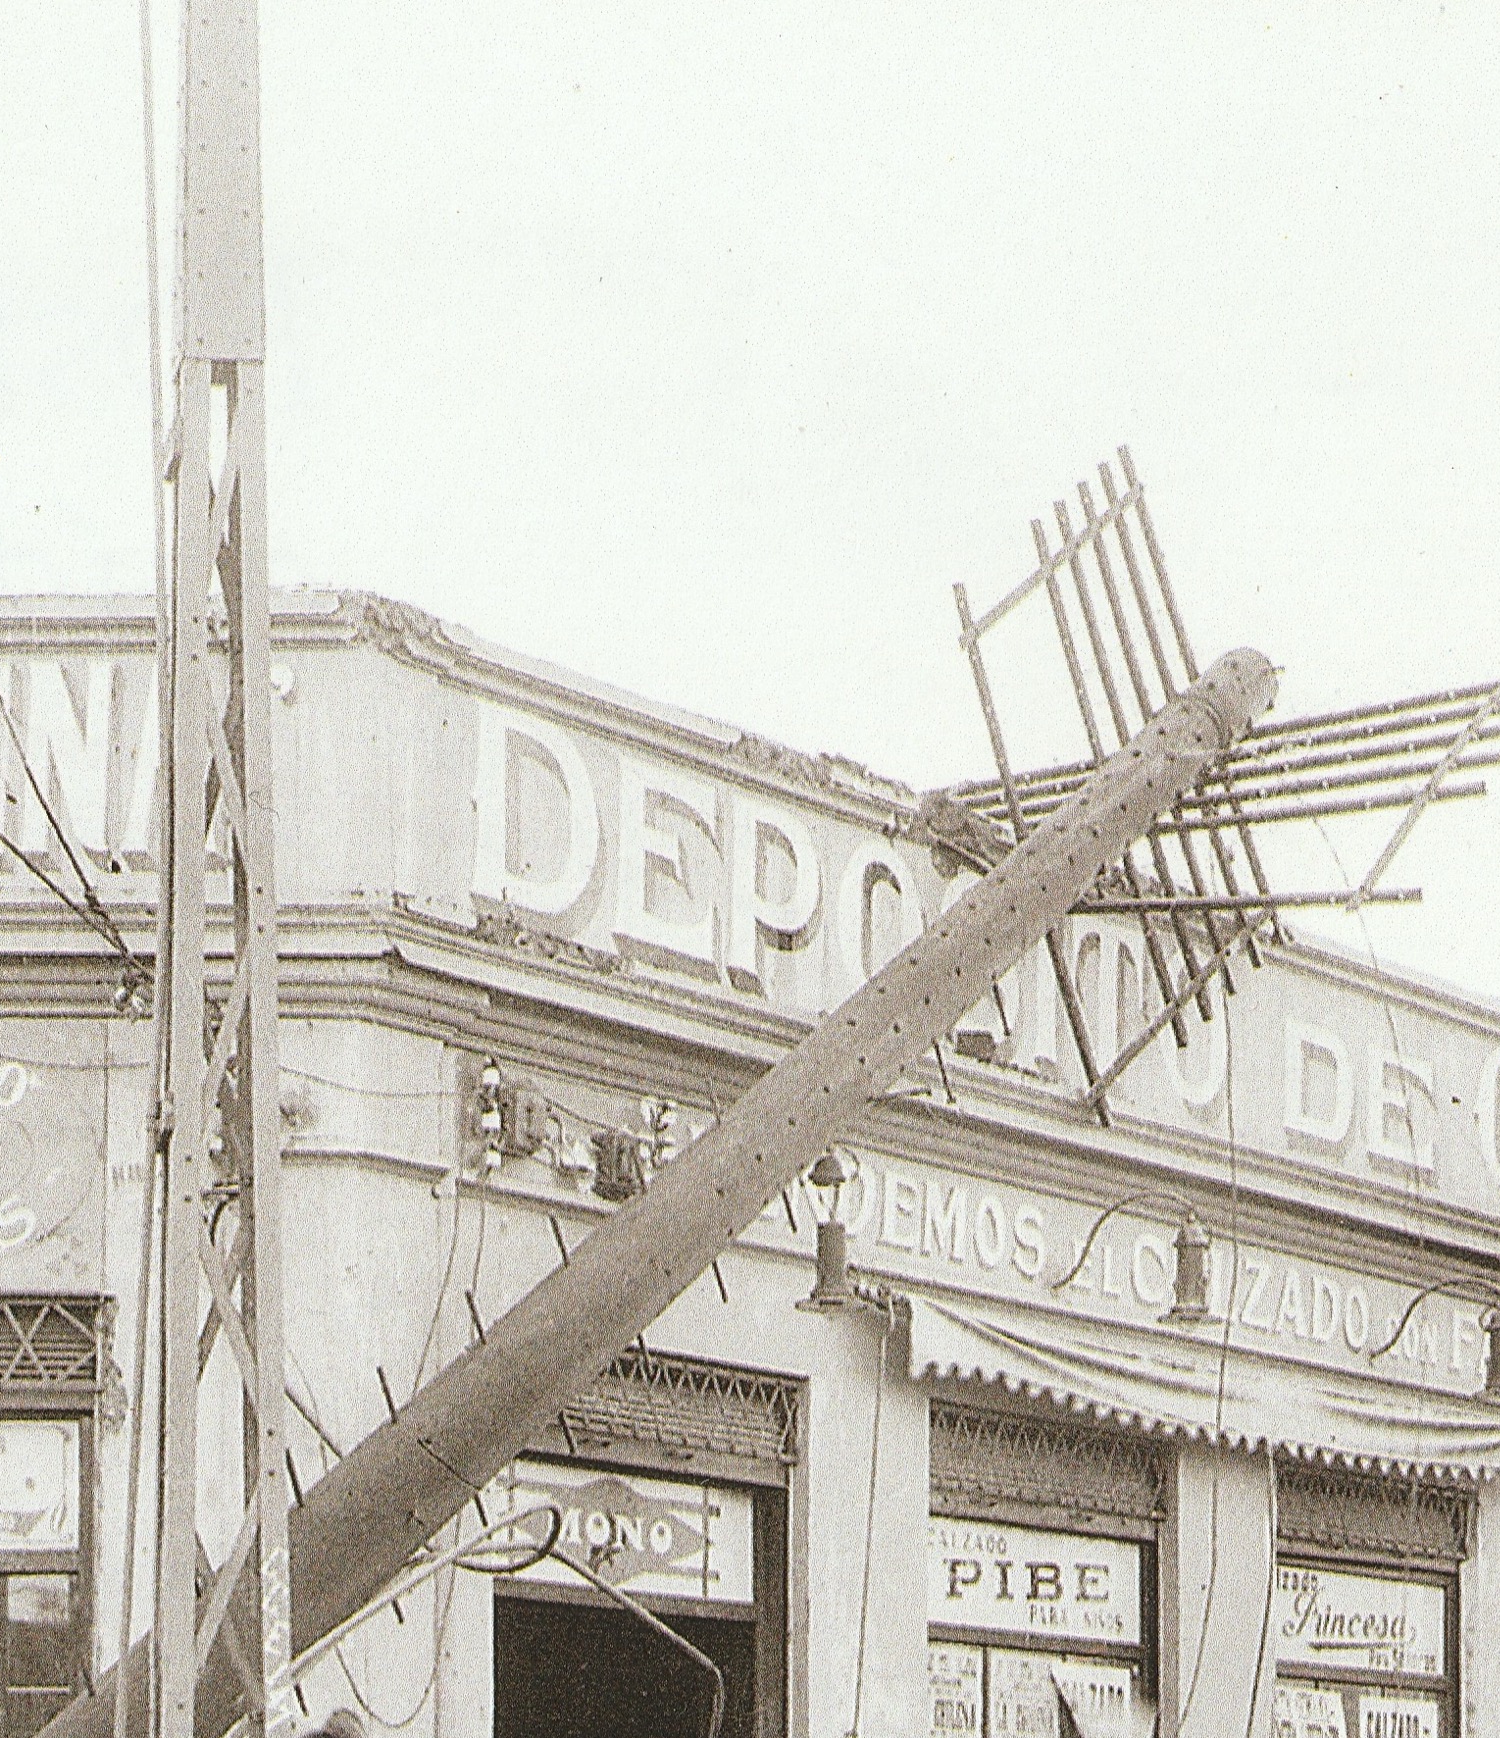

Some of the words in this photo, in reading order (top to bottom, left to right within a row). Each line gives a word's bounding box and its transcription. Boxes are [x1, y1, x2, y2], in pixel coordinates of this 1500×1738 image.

[1281, 1020, 1438, 1178] DE
[1130, 1233, 1373, 1351] CLZADO
[941, 1557, 1111, 1604] PIBE
